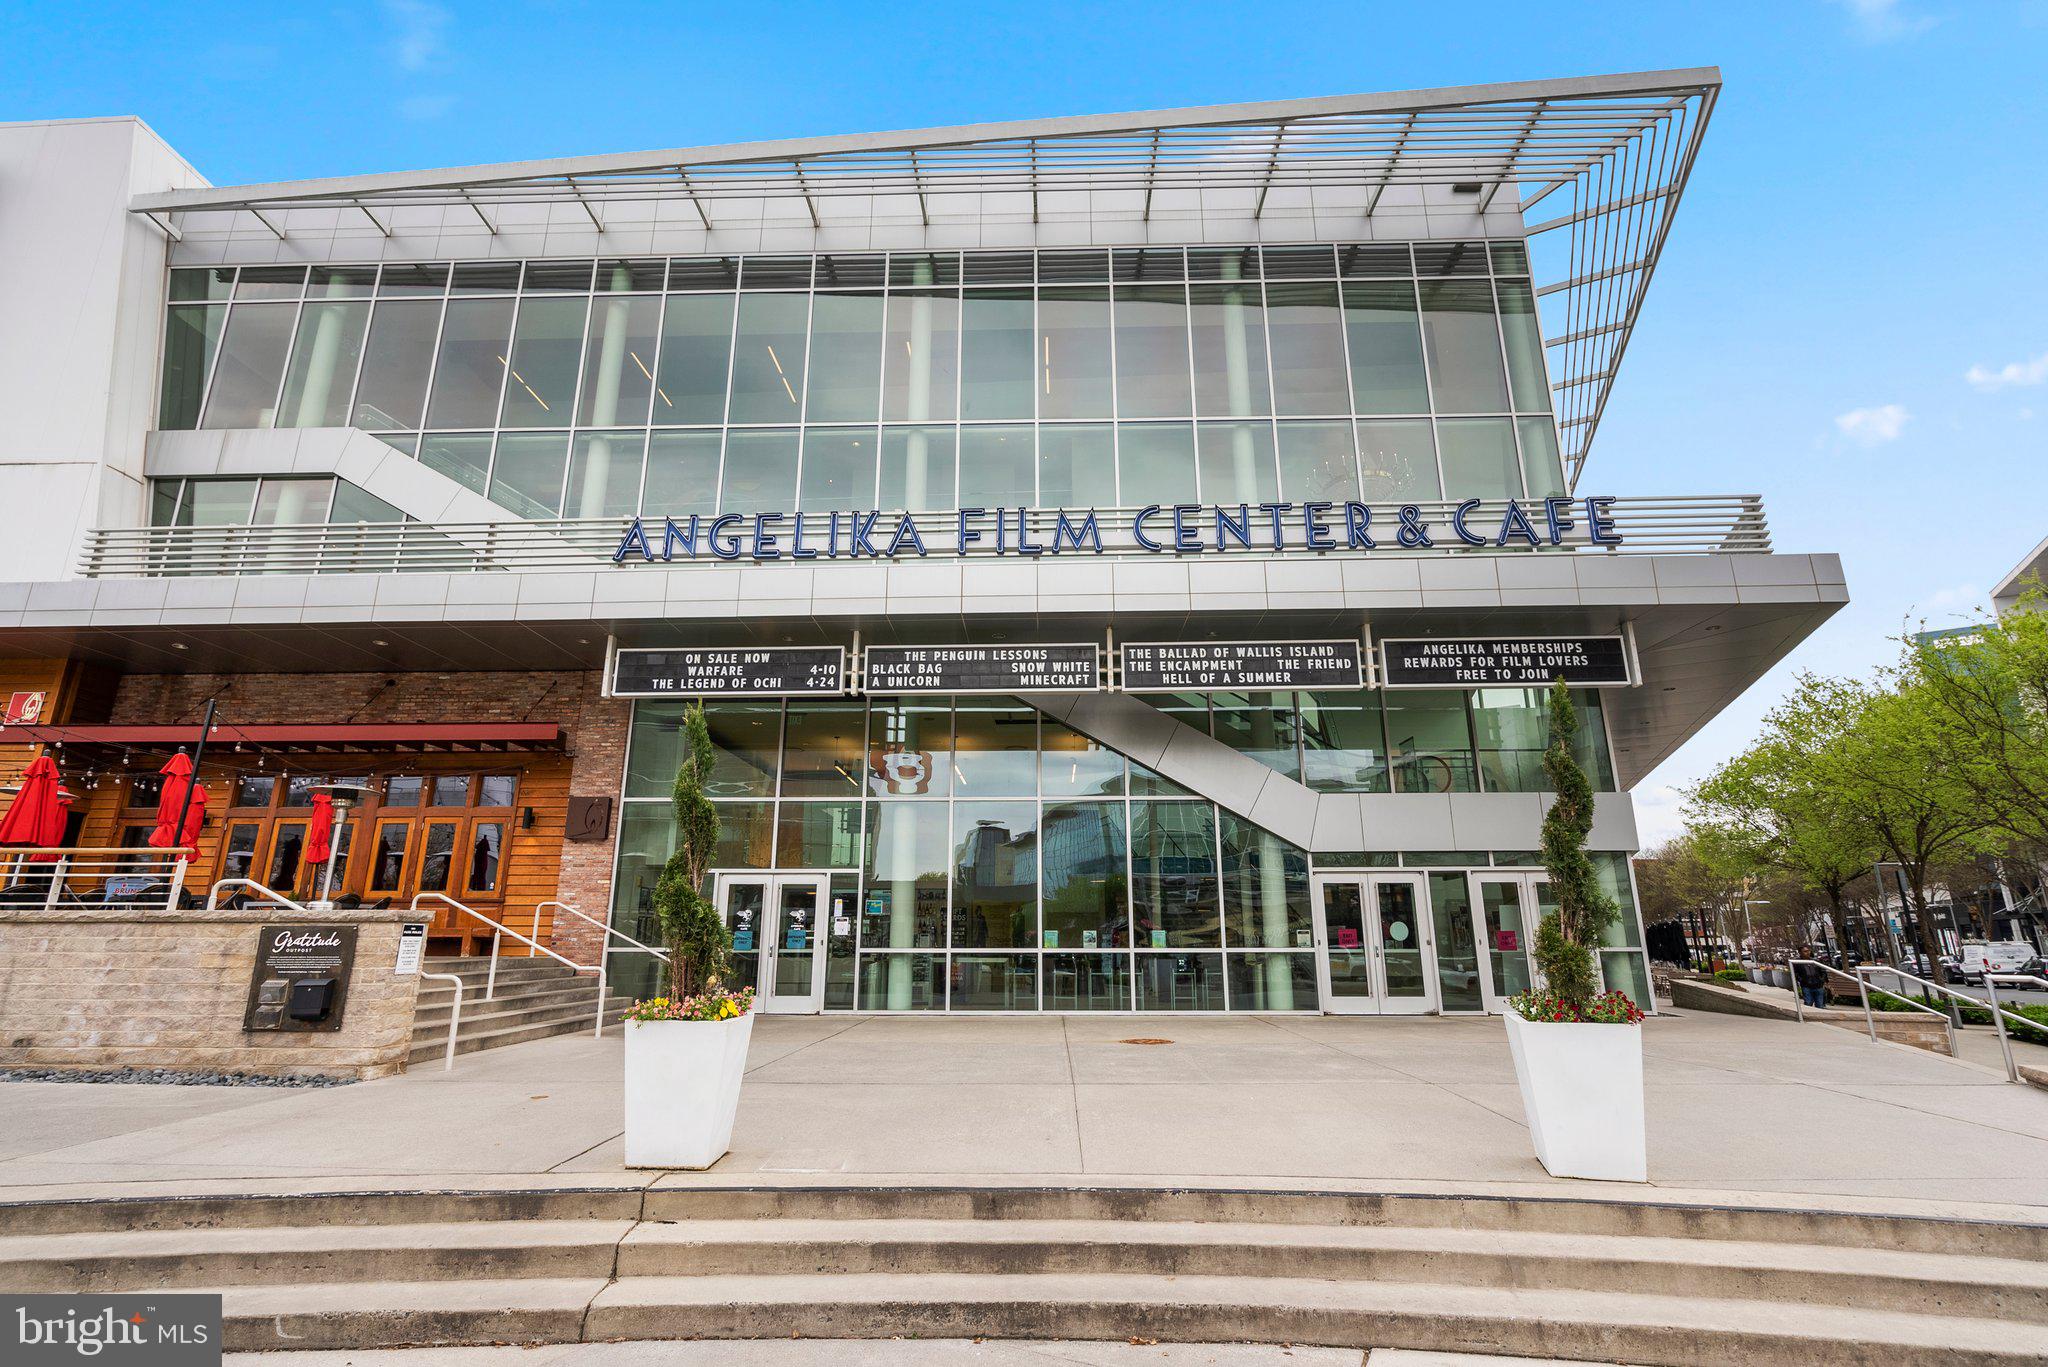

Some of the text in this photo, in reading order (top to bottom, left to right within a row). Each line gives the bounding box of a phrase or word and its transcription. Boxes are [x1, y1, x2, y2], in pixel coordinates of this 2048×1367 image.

[612, 496, 1624, 562] ANGELIKA FILM CENTER & CAFE
[1129, 646, 1334, 659] THE BALLAD OF WALLIS ISLAND
[1423, 642, 1583, 655] ANGELIKA MEMBERSHIPS
[685, 653, 770, 664] ON SALE NOW
[904, 650, 1048, 662] THE PENGUIN LESSONS
[1404, 655, 1589, 668] REWARDS FOR FILM LOVERS
[688, 664, 837, 676] WARFARE 4-10
[872, 663, 943, 674] BLACK BAG
[1011, 662, 1090, 673] SNOW WHITE
[1129, 660, 1243, 672] THE ENCAMPMENT
[1277, 658, 1352, 670] THE FRIEND
[1020, 674, 1090, 686] MINECRAFT
[1162, 672, 1291, 684] HELL OF A SUMMER
[1456, 668, 1549, 680] FREE TO JOIN
[652, 677, 835, 689] THE LEGEND OF OCHI 4-24
[872, 676, 940, 687] A UNICORN
[272, 931, 341, 953] Gratitude
